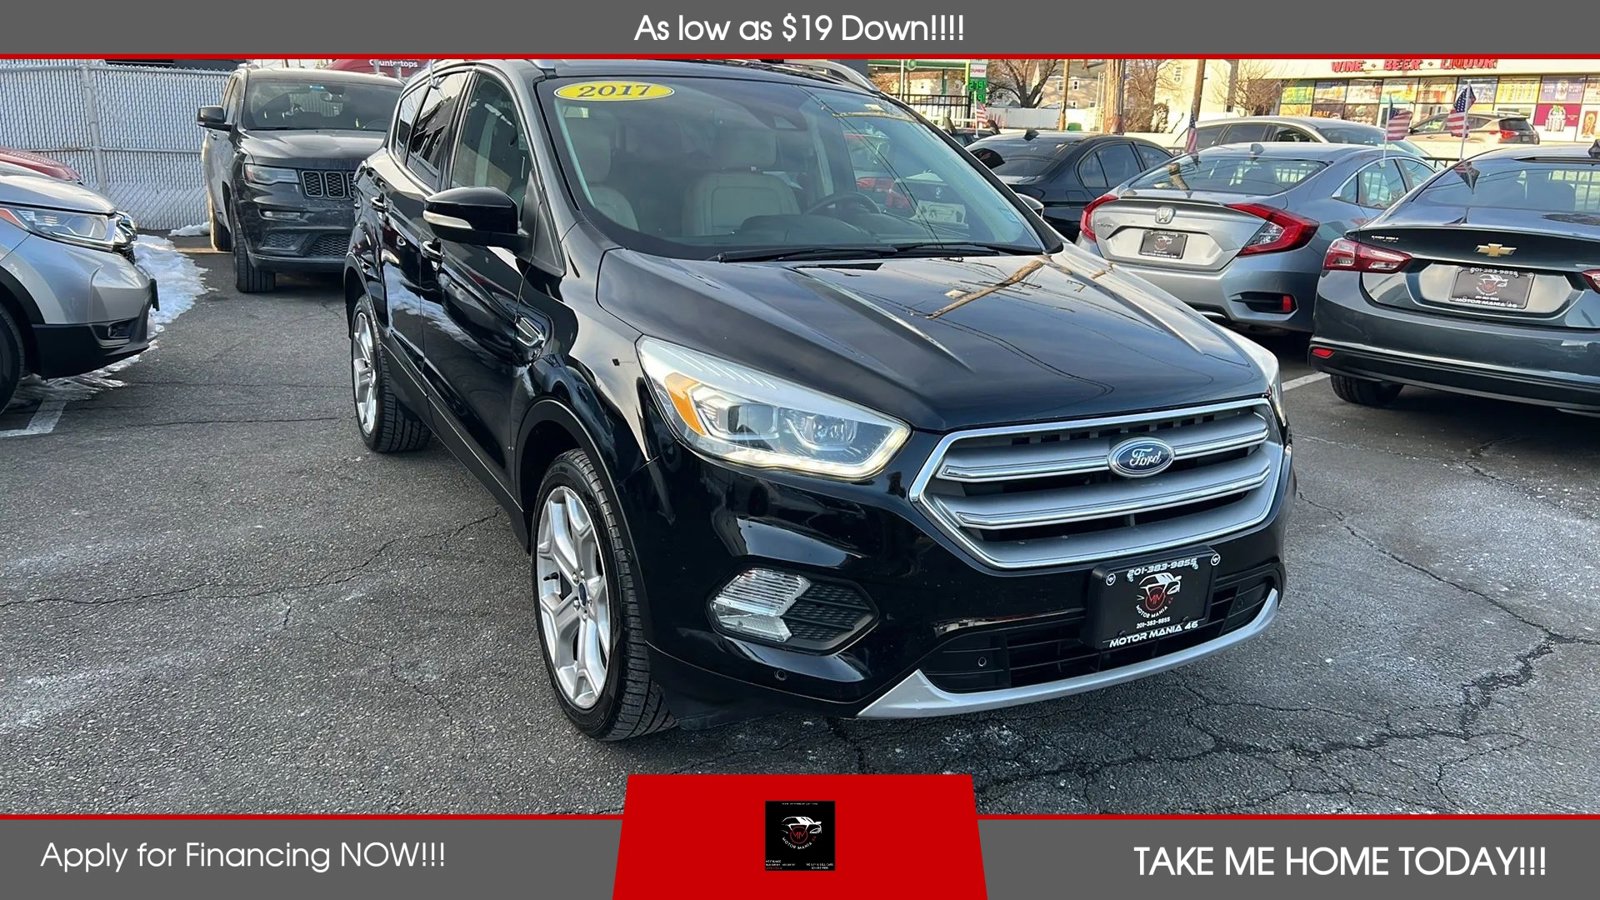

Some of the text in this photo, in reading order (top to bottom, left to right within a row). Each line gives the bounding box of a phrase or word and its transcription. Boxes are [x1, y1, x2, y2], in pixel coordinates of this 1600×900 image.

[1331, 60, 1365, 72] WINE
[1384, 59, 1422, 70] BEER
[577, 85, 651, 97] 2017
[1129, 448, 1162, 467] Ford
[1136, 604, 1150, 618] MOTOR
[1109, 620, 1199, 648] MOTOR MANIA 46
